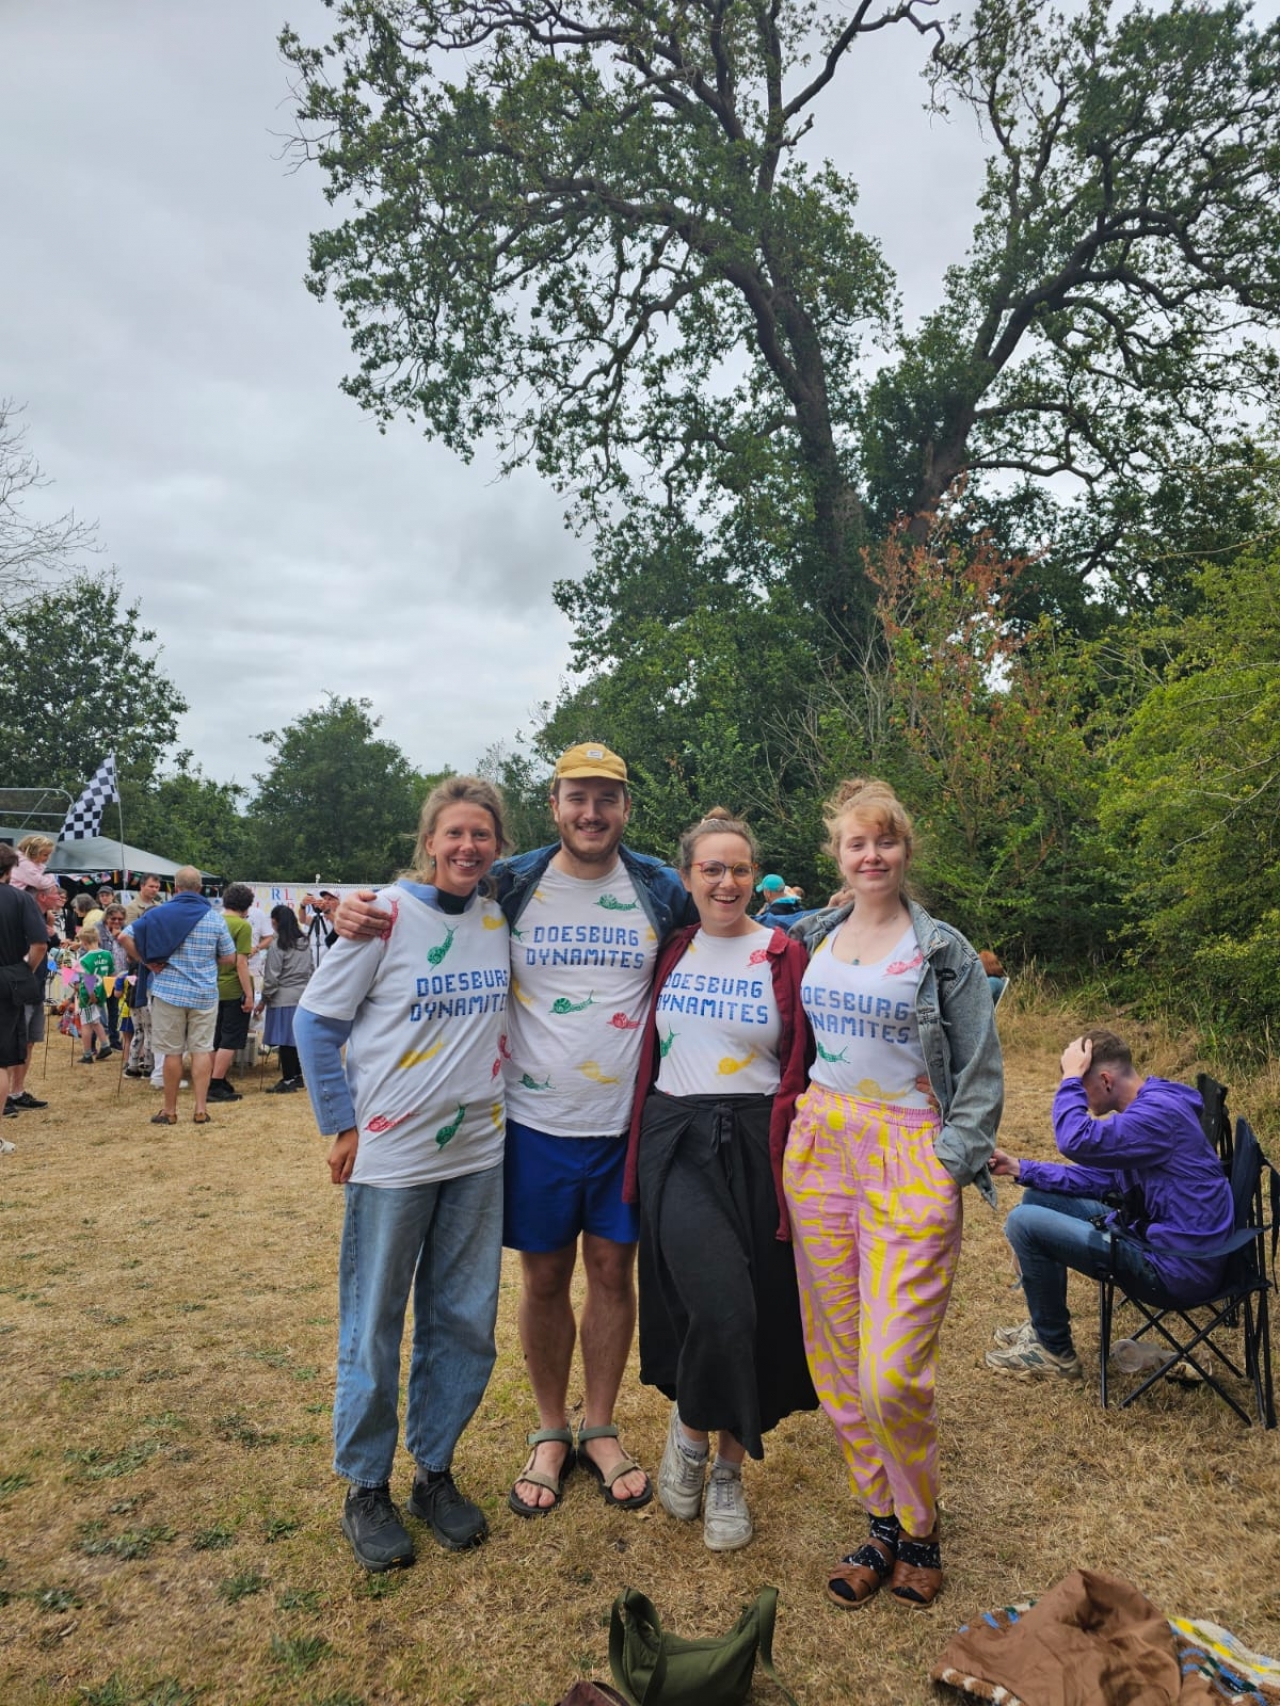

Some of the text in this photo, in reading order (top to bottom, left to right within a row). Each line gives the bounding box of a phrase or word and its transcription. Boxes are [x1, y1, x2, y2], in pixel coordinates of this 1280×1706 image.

[534, 925, 639, 947] DOESBURG
[526, 948, 645, 969] DYNAMITES
[410, 993, 507, 1022] DYNAMIT
[802, 985, 909, 1021] OESBURG
[806, 1010, 911, 1044] NAMITES
